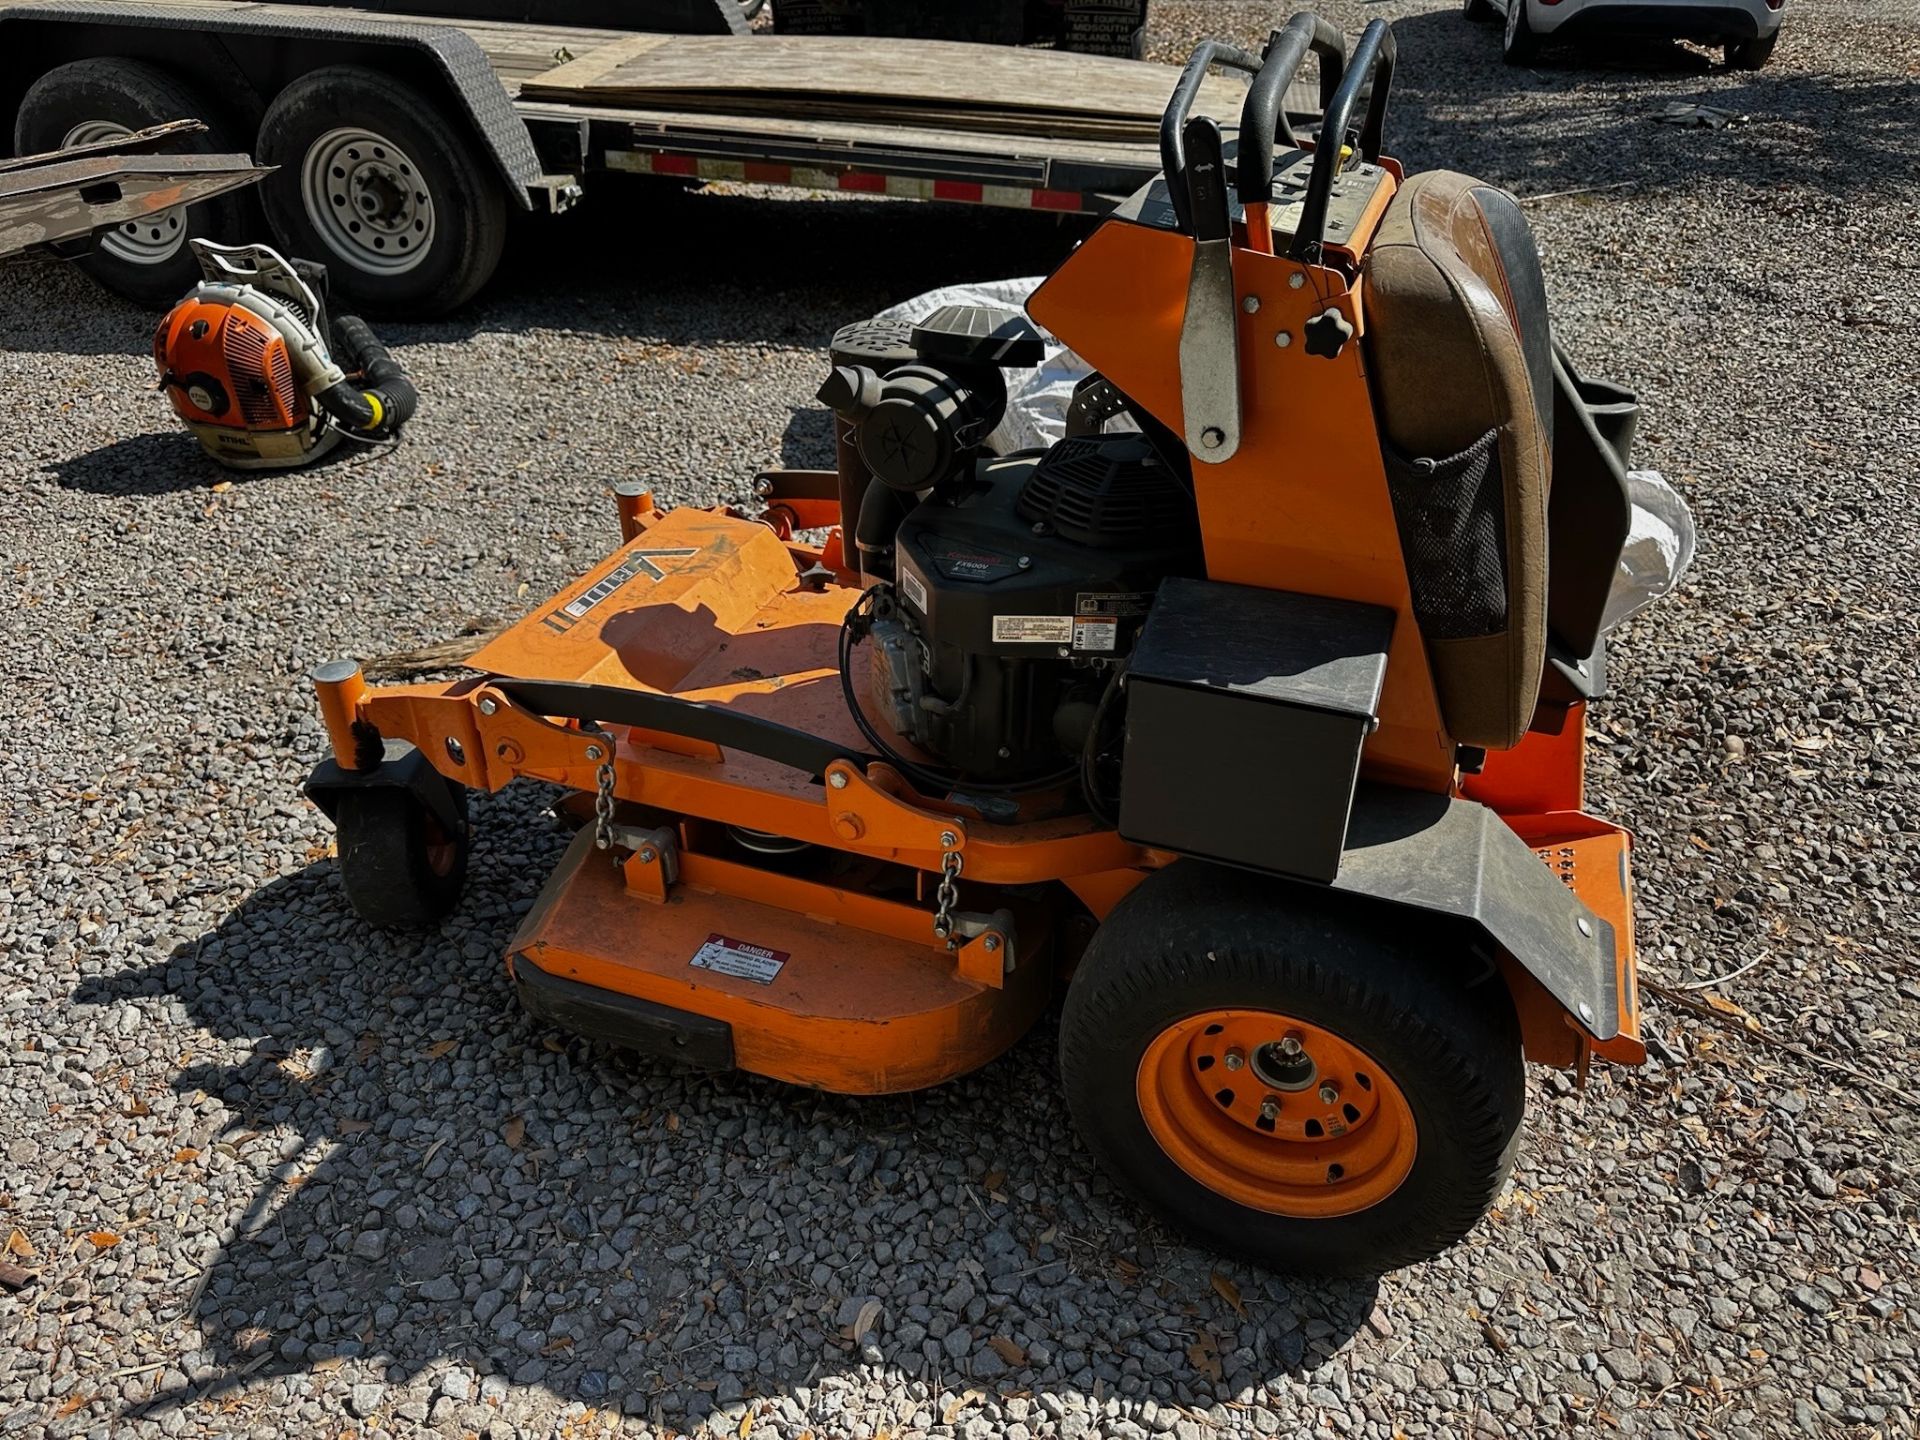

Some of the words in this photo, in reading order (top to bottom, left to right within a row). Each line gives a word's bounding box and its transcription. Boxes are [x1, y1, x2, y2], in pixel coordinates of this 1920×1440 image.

[1072, 23, 1129, 33] MIDSOUTH
[218, 435, 251, 446] STIHL
[736, 942, 775, 958] DANGER
